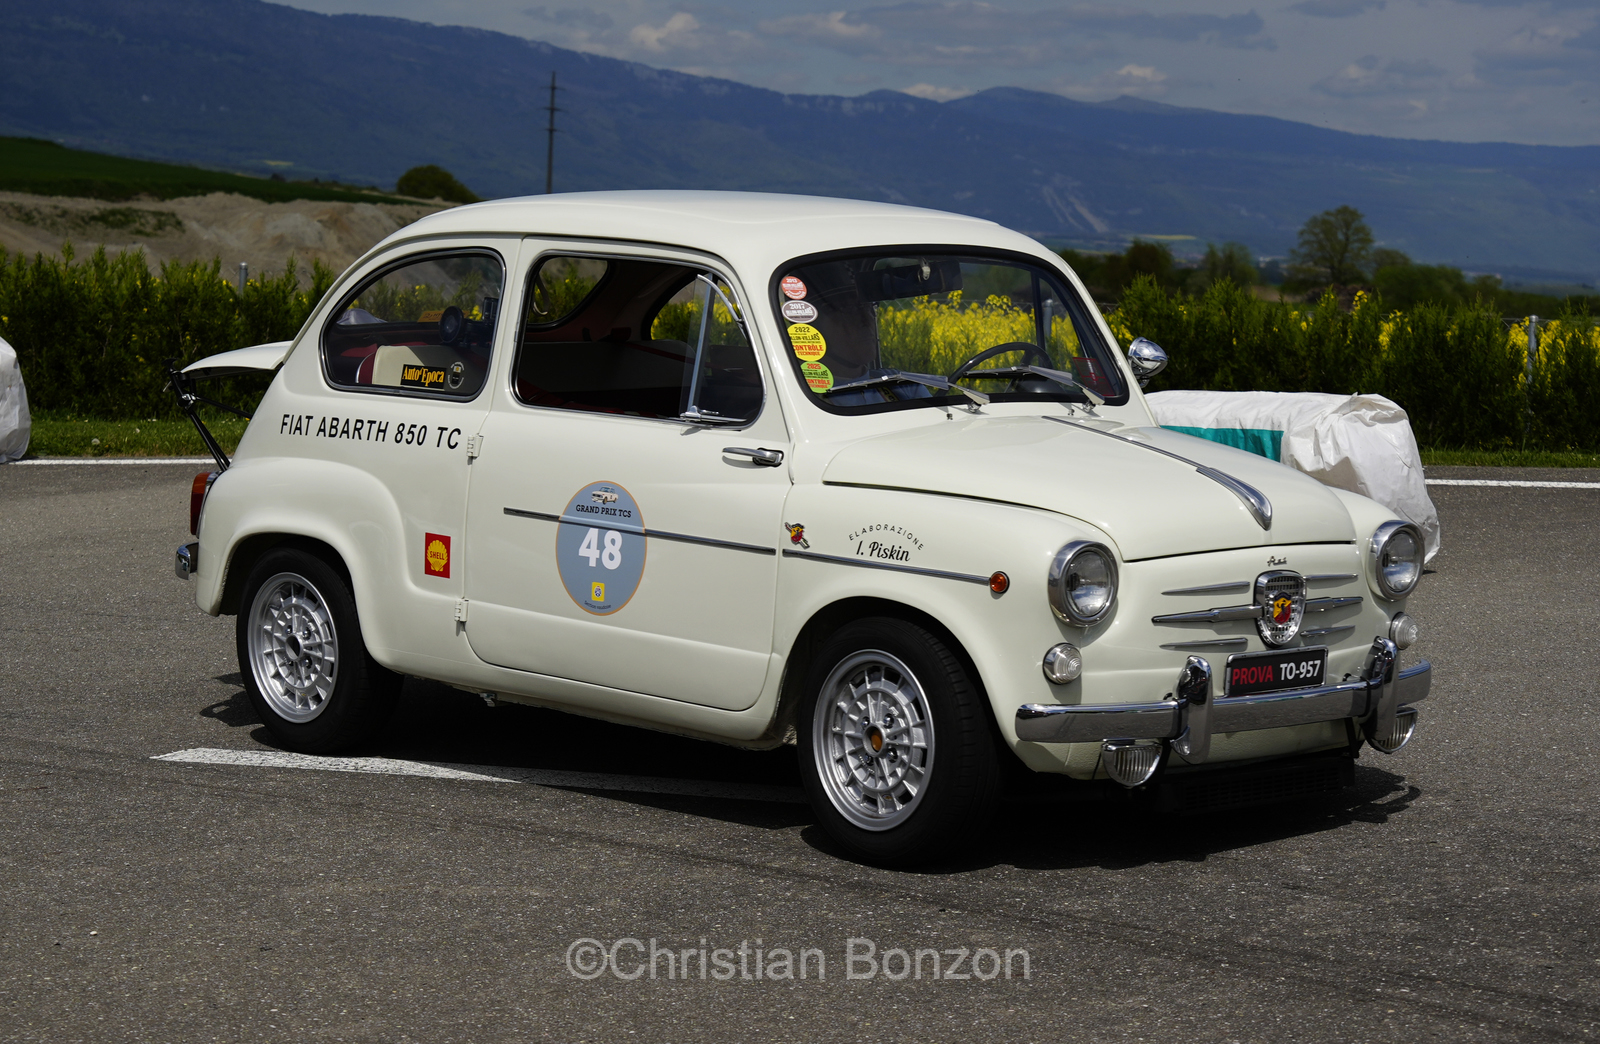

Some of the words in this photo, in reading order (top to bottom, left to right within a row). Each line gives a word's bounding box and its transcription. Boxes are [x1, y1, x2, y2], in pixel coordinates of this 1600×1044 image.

[280, 414, 314, 436] FIAT
[316, 416, 389, 442] ABARTH
[394, 422, 428, 446] 850
[436, 426, 462, 450] TC
[575, 504, 600, 514] GRAND
[600, 507, 617, 516] PRIX
[618, 509, 632, 518] TCS
[578, 527, 623, 570] 48
[849, 524, 924, 550] ELABORAZIONE
[430, 551, 444, 560] SHELL
[869, 541, 910, 561] Piskin
[1232, 665, 1274, 686] PROVA
[1279, 660, 1321, 681] TO-957
